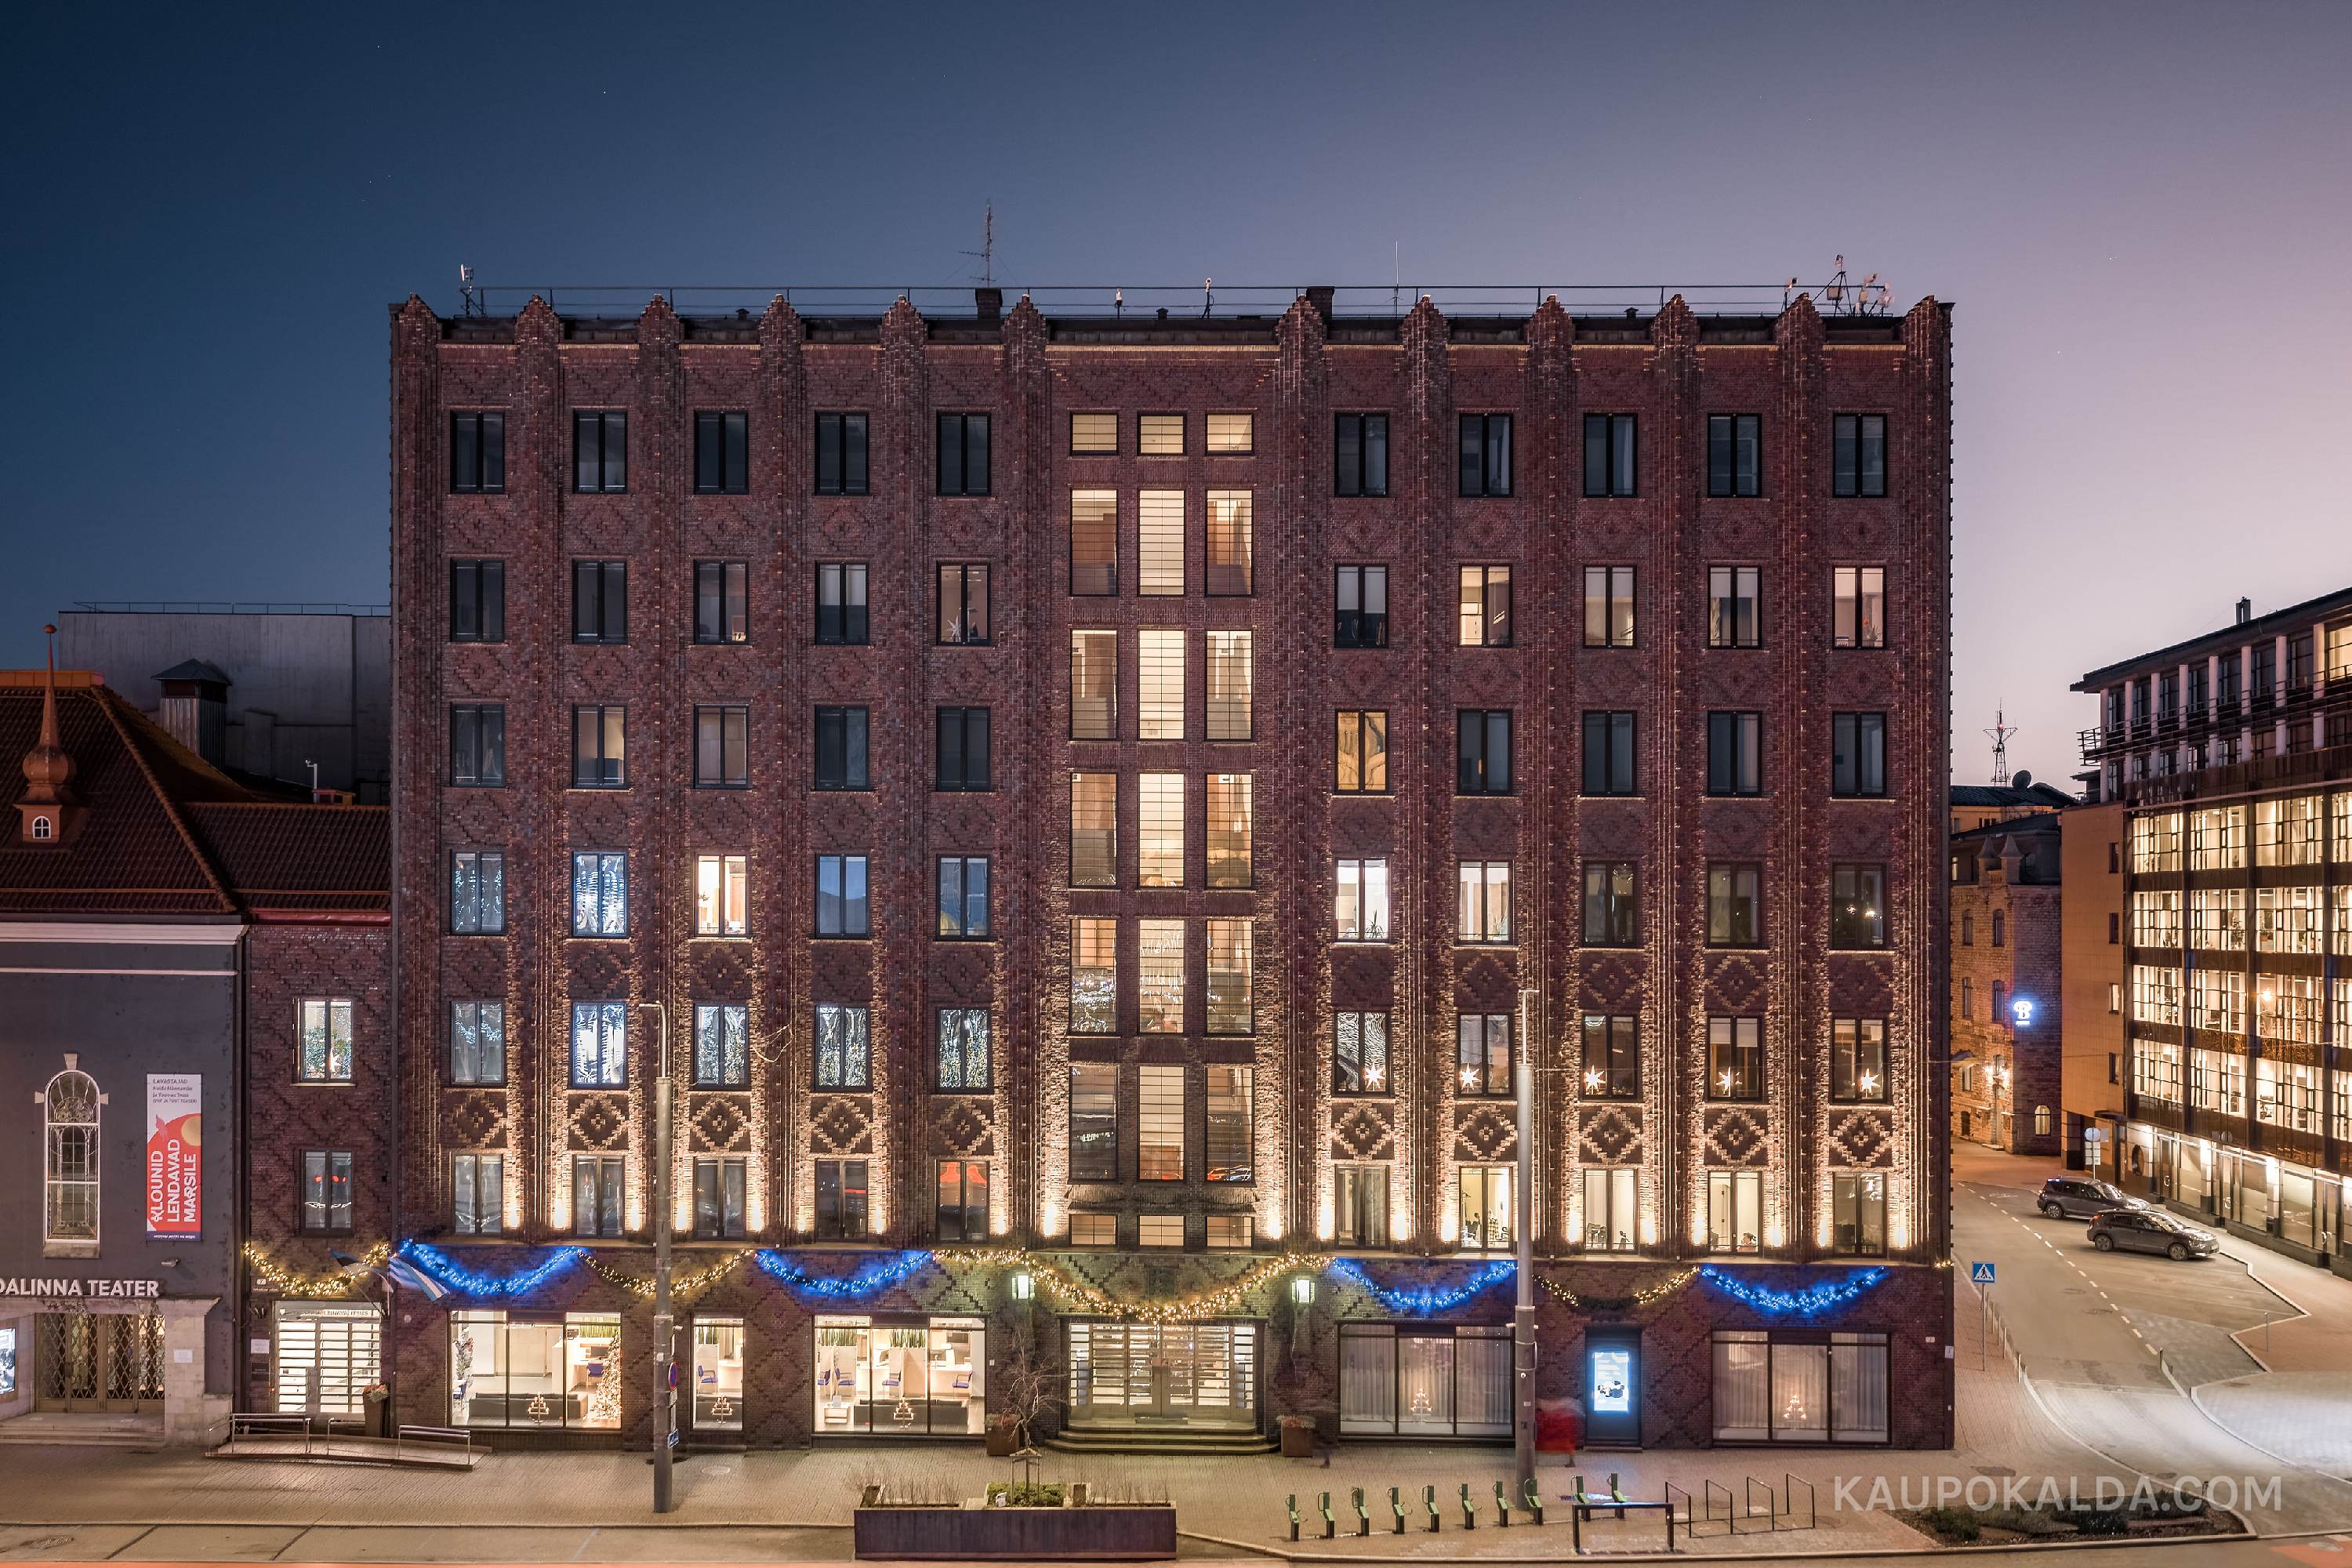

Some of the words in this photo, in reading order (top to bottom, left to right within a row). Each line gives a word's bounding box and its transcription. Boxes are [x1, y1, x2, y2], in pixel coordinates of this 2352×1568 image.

[151, 1150, 164, 1222] KLOUNID
[167, 1138, 180, 1222] LENDAVAD
[183, 1153, 198, 1222] MARSILE
[87, 1279, 159, 1297] TEATER
